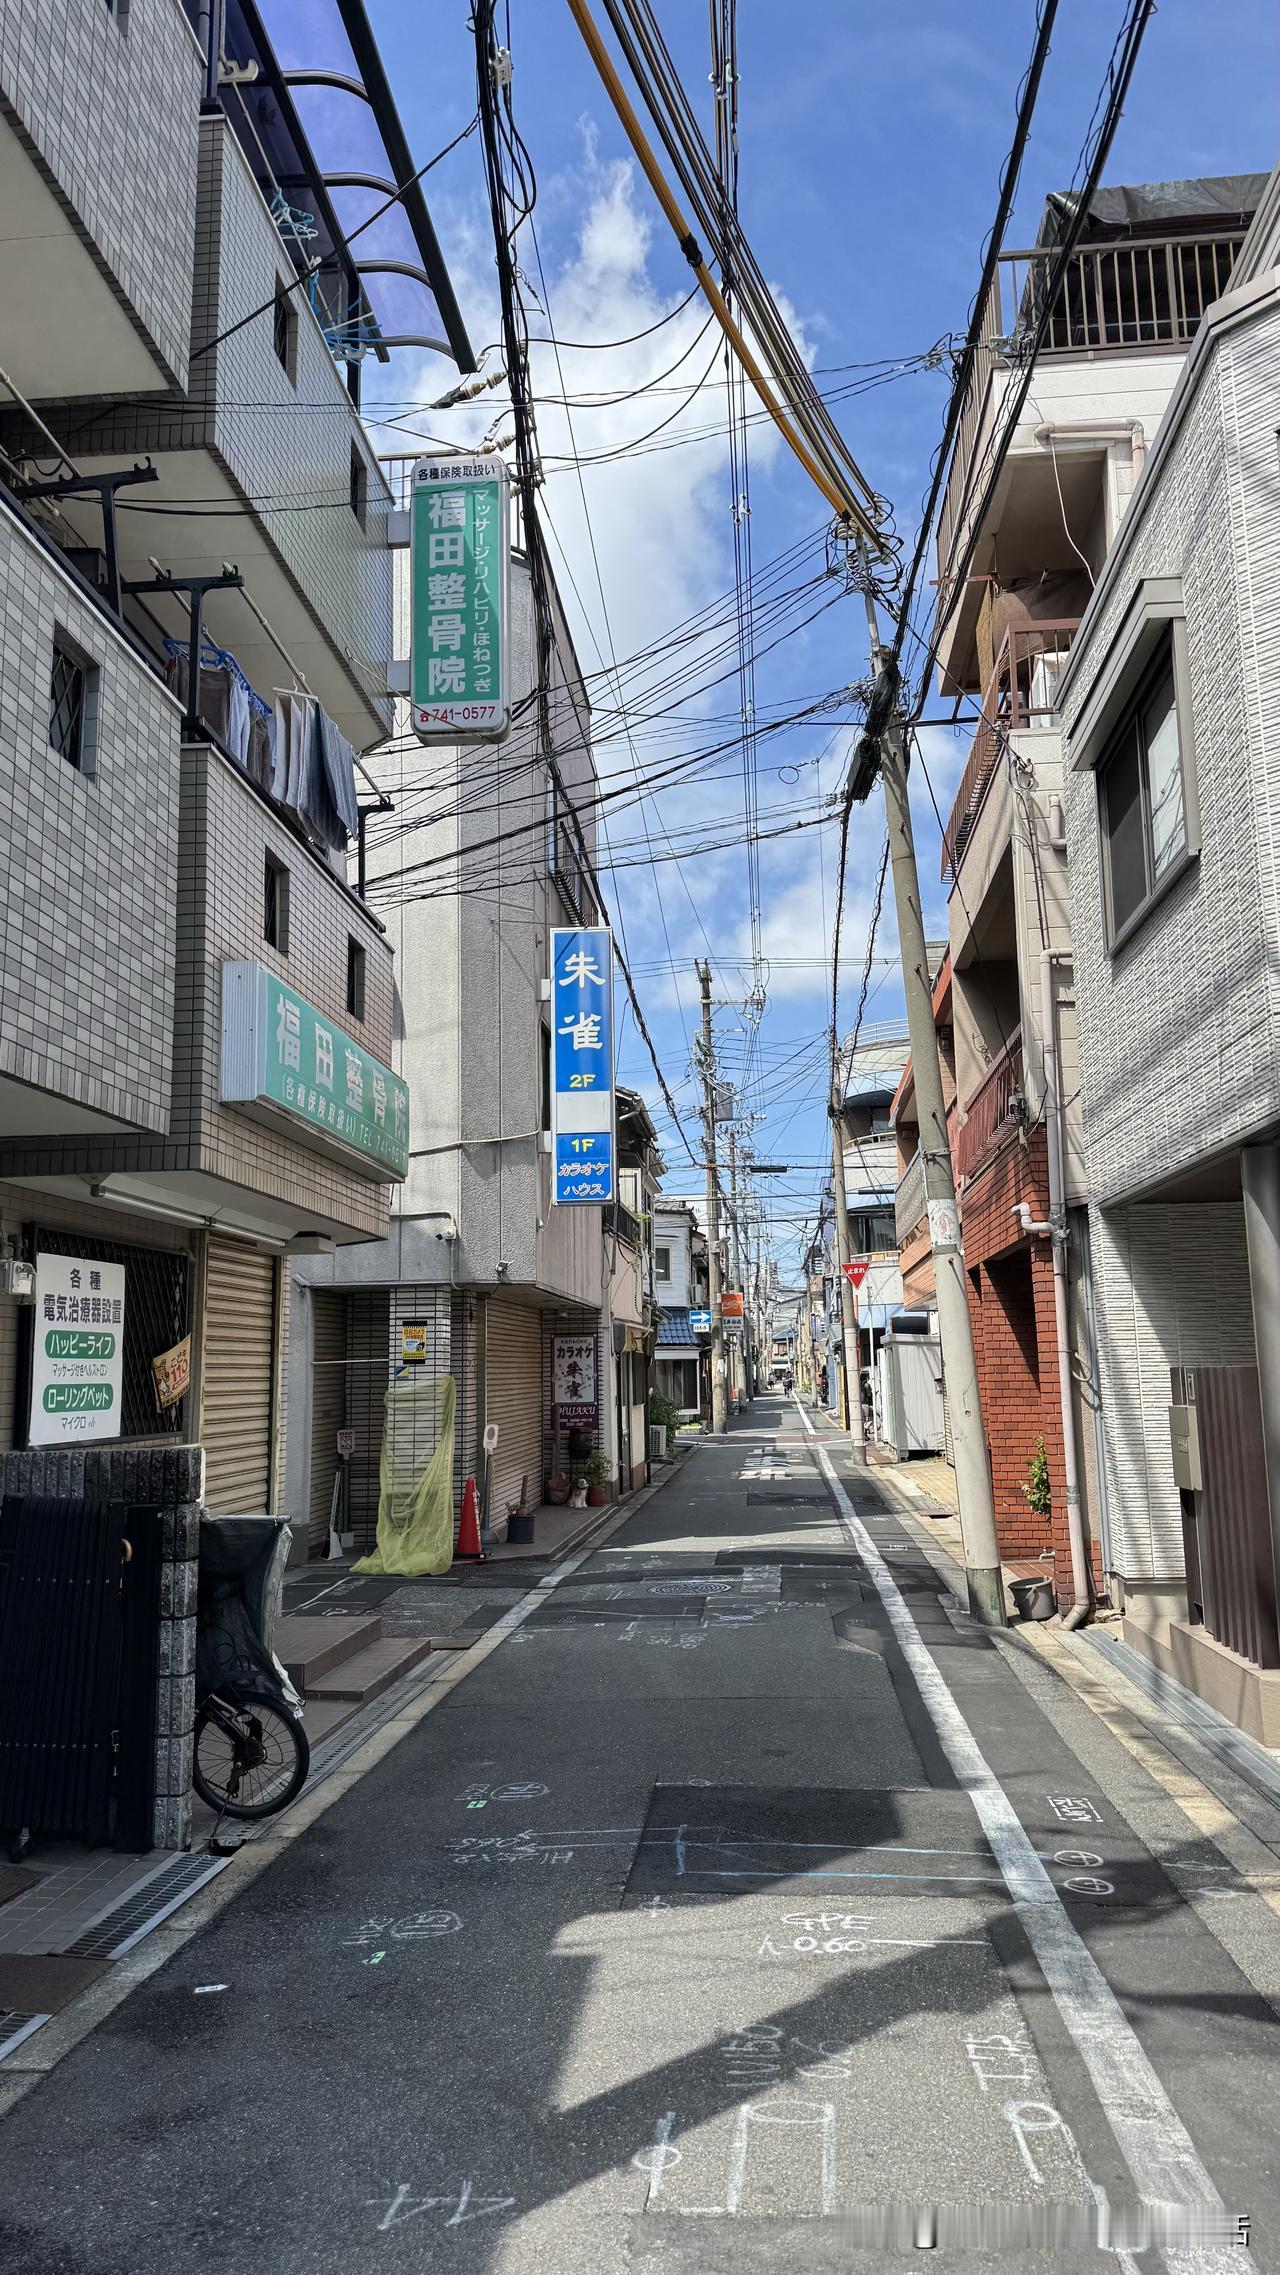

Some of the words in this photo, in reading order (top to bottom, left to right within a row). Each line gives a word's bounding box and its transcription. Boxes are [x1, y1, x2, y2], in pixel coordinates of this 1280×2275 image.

[418, 464, 496, 481] 各種保険取扱い
[427, 490, 467, 696] 福田整骨院
[558, 951, 606, 1050] 朱雀
[570, 1074, 596, 1088] 2F
[571, 1138, 595, 1153] 1F
[558, 1162, 609, 1176] カラオケ
[563, 1182, 605, 1197] ハウス
[43, 1293, 122, 1324] 電気治療器設置
[50, 1333, 112, 1355] ハッピーライフ
[556, 1345, 593, 1359] カラオケ
[171, 1358, 188, 1382] 110
